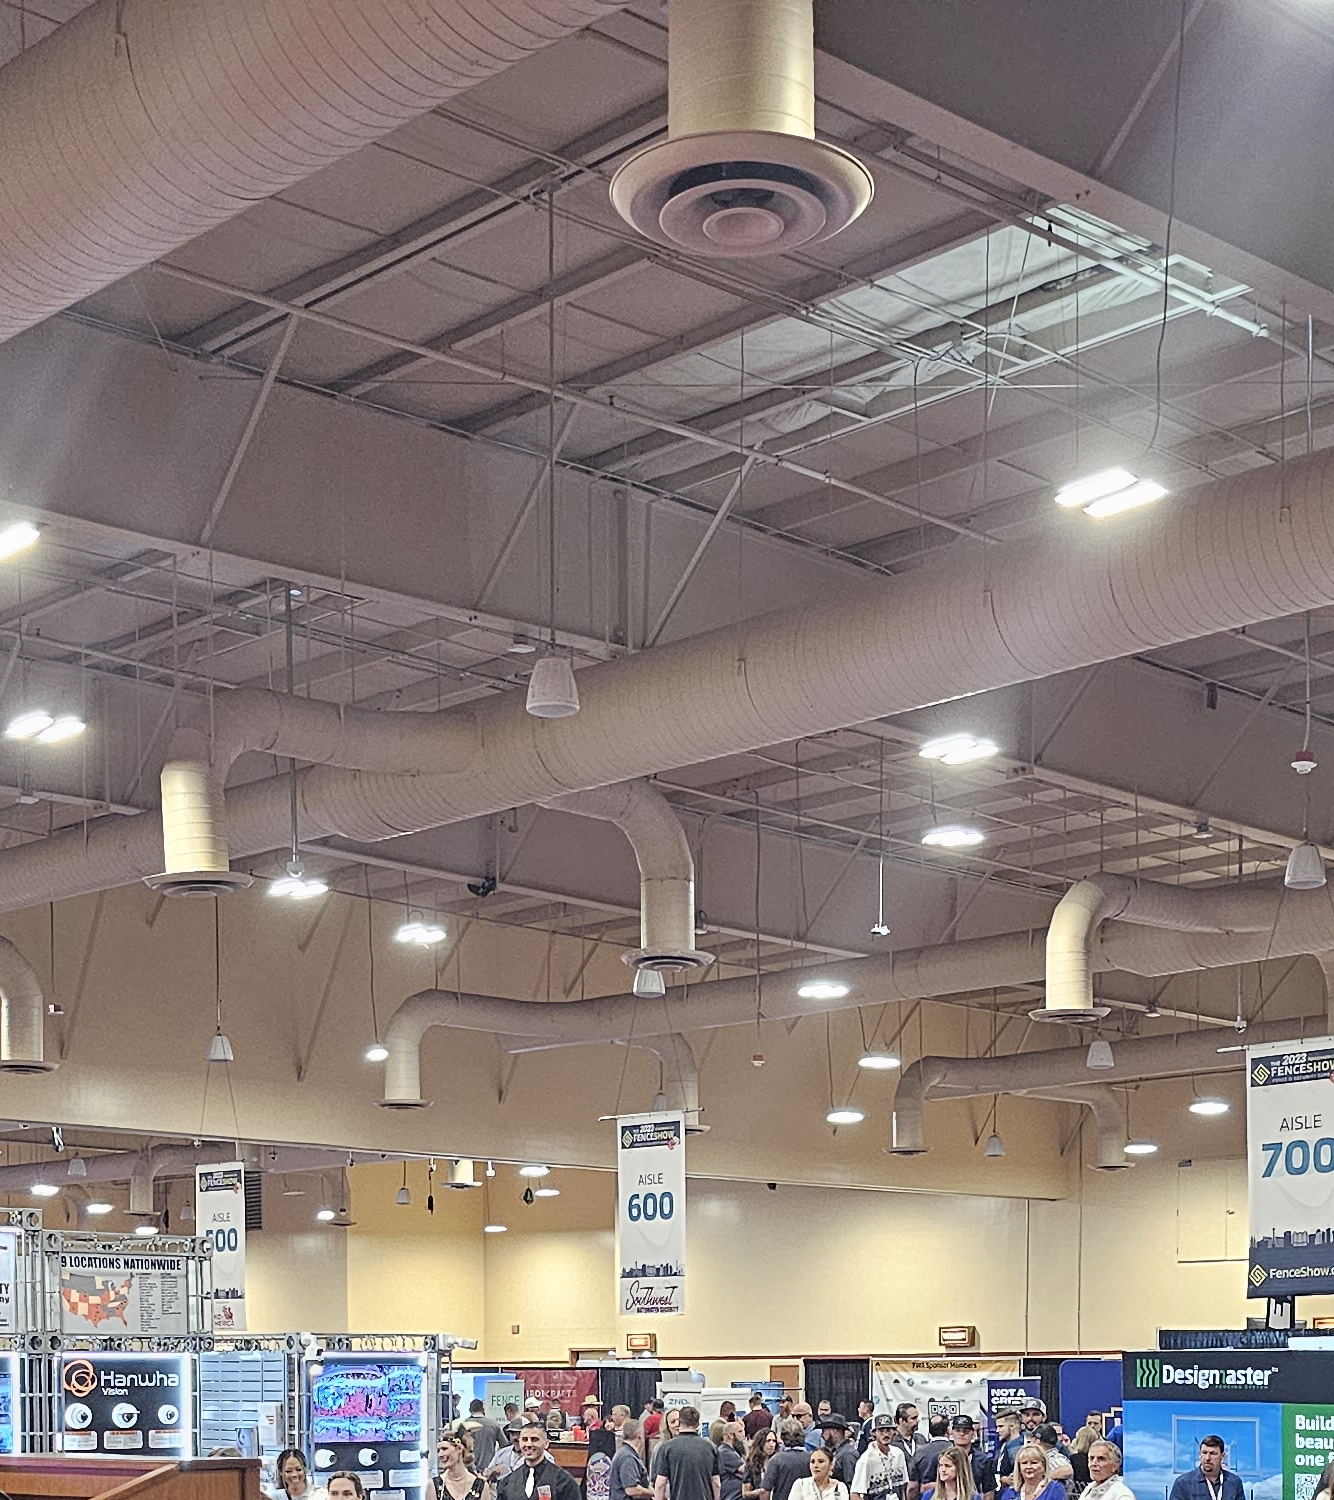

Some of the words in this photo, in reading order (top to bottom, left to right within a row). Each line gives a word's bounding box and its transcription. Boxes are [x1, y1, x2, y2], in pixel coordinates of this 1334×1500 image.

[1282, 1053, 1307, 1065] 2023
[1279, 1114, 1323, 1131] AISLE
[634, 1131, 675, 1142] FENCESHOW
[638, 1173, 664, 1186] AISLE
[628, 1191, 674, 1222] 600
[212, 1213, 231, 1223] AISLE
[69, 1256, 121, 1269] LOCATIONS
[123, 1259, 181, 1271] NATIONWIDE
[101, 1371, 180, 1386] Hanwha
[1162, 1365, 1272, 1389] Designmaster
[492, 1395, 519, 1406] FENCE
[1295, 1456, 1324, 1466] one
